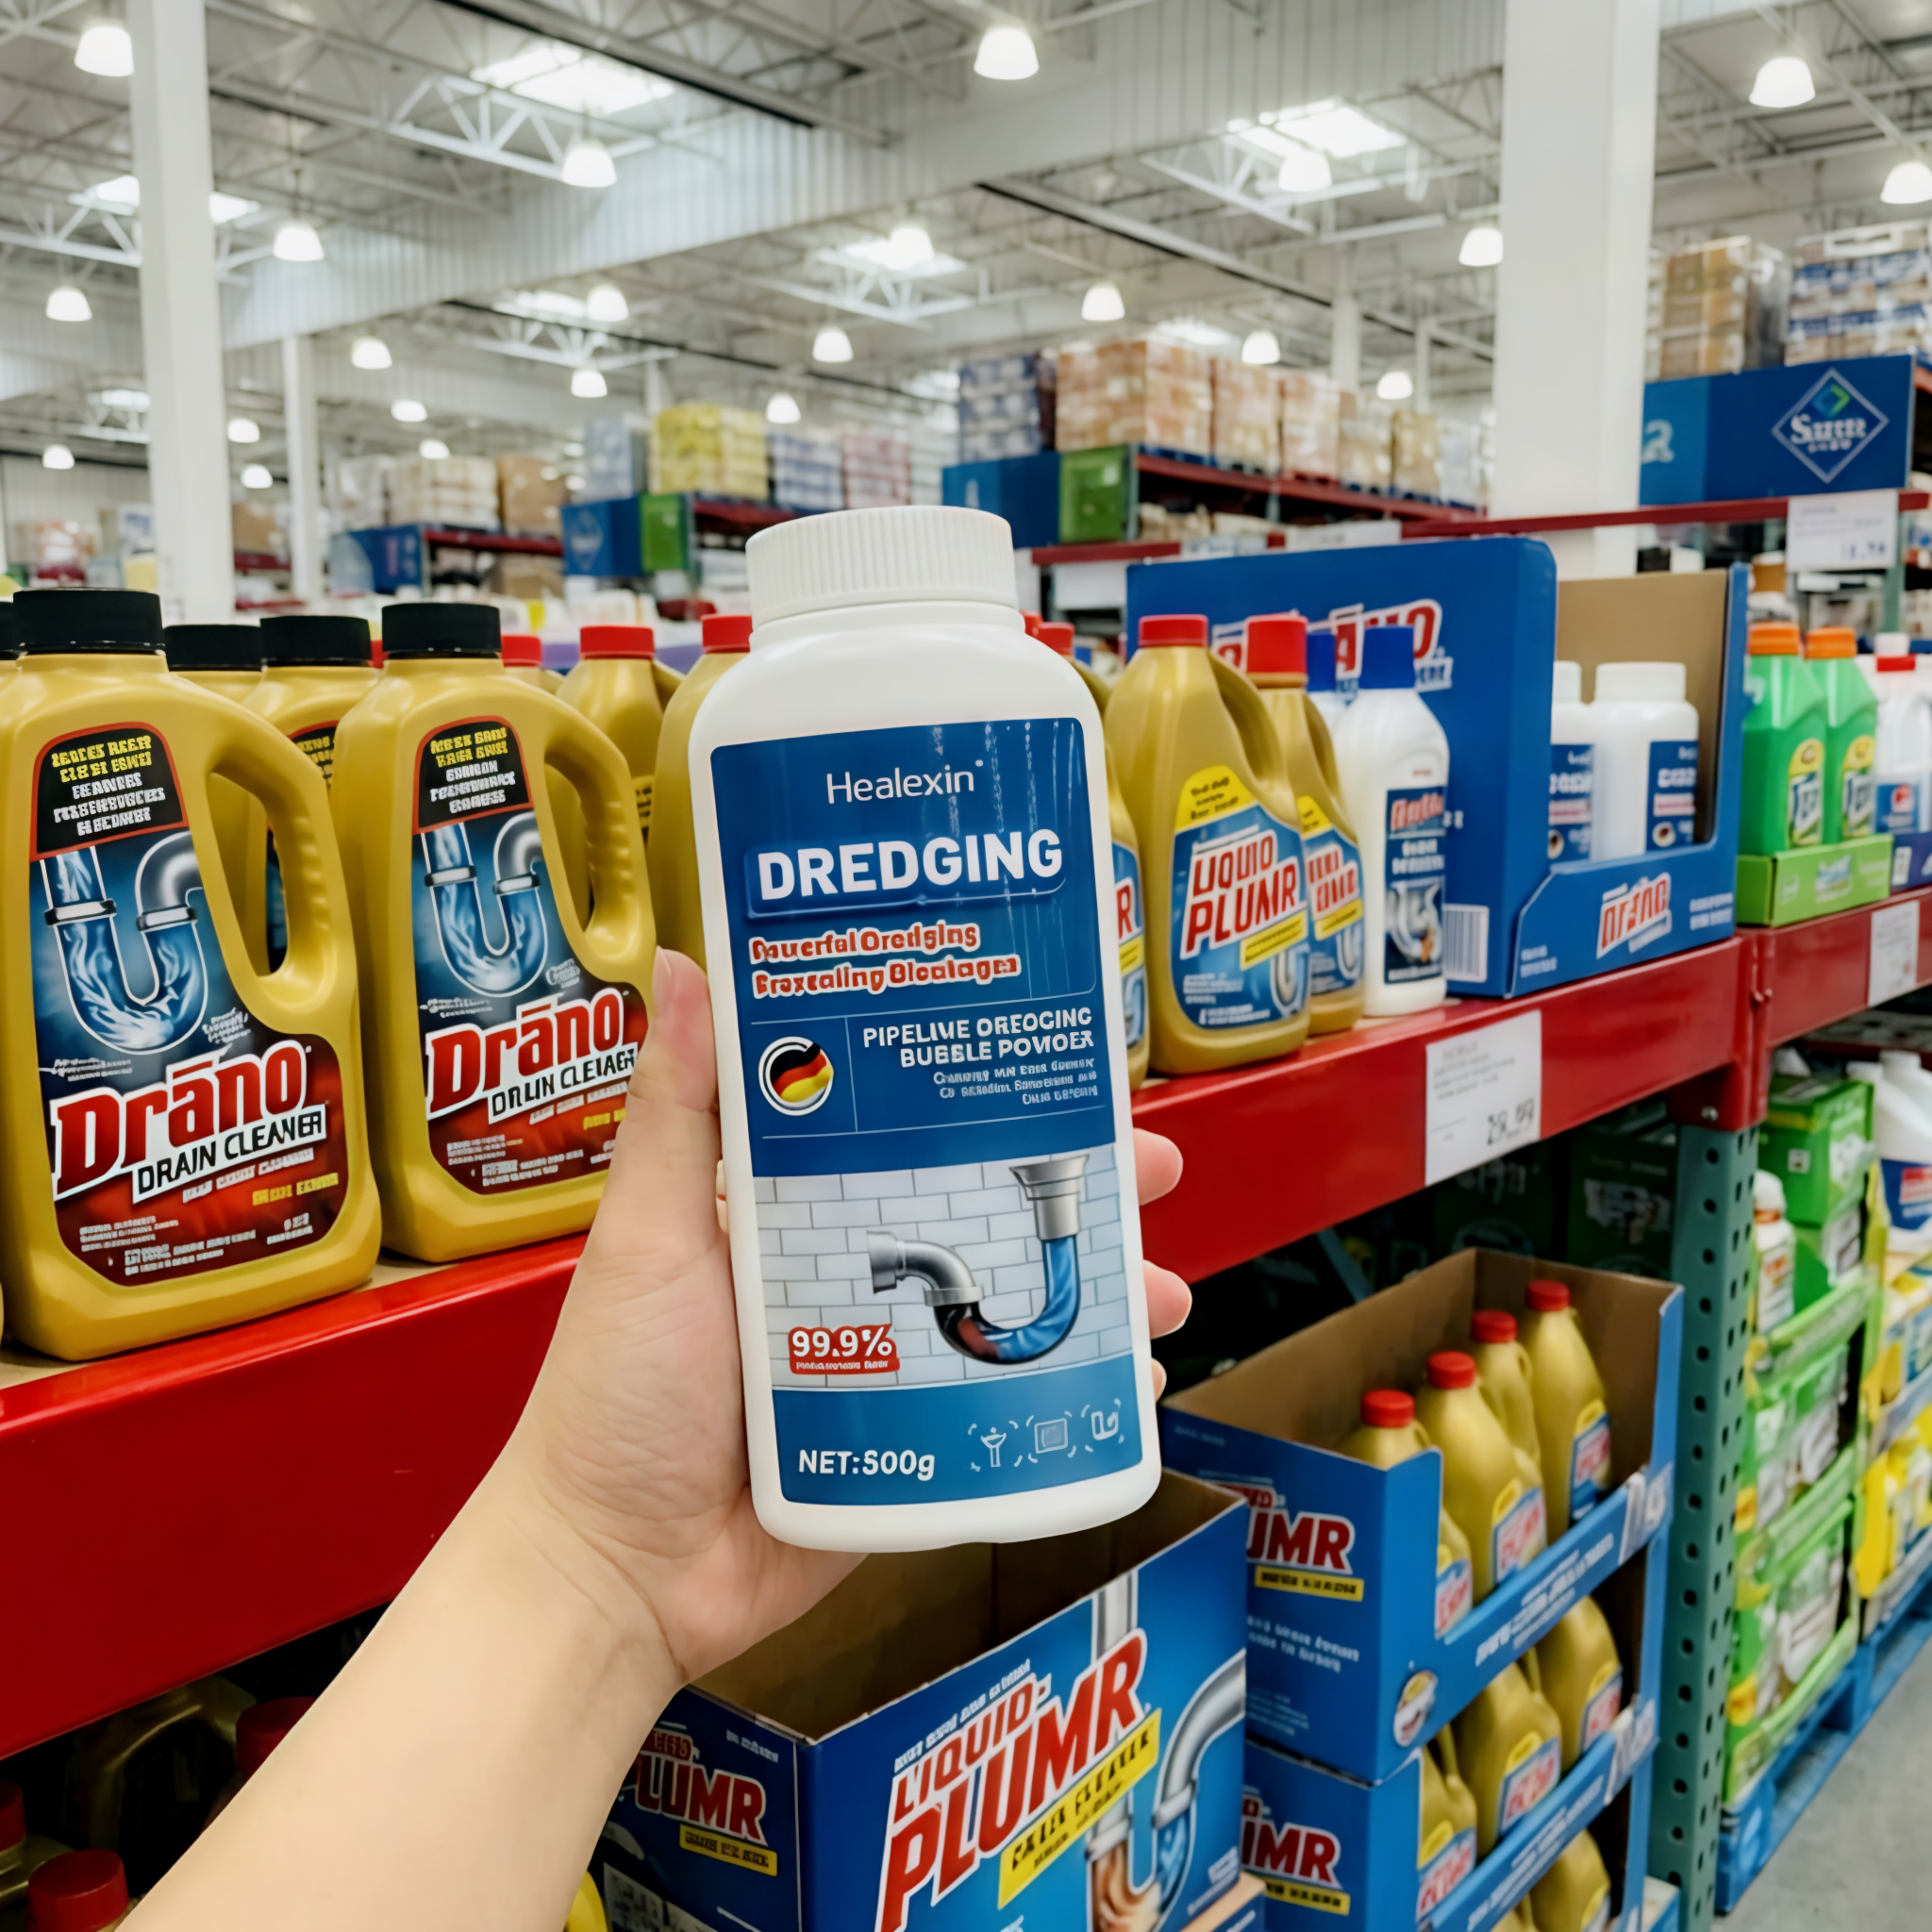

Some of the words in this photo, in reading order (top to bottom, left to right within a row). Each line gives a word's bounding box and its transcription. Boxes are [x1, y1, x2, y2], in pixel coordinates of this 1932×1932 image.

[826, 765, 975, 805] Healexin
[758, 828, 1063, 901] DREDGING
[137, 1140, 217, 1195] DRAIN
[224, 1110, 322, 1160] CLEANER
[791, 1325, 892, 1357] 99.9%
[875, 1629, 1147, 1932] PLUMR
[891, 1678, 1038, 1828] LIQUID
[636, 1753, 769, 1847] LUMR
